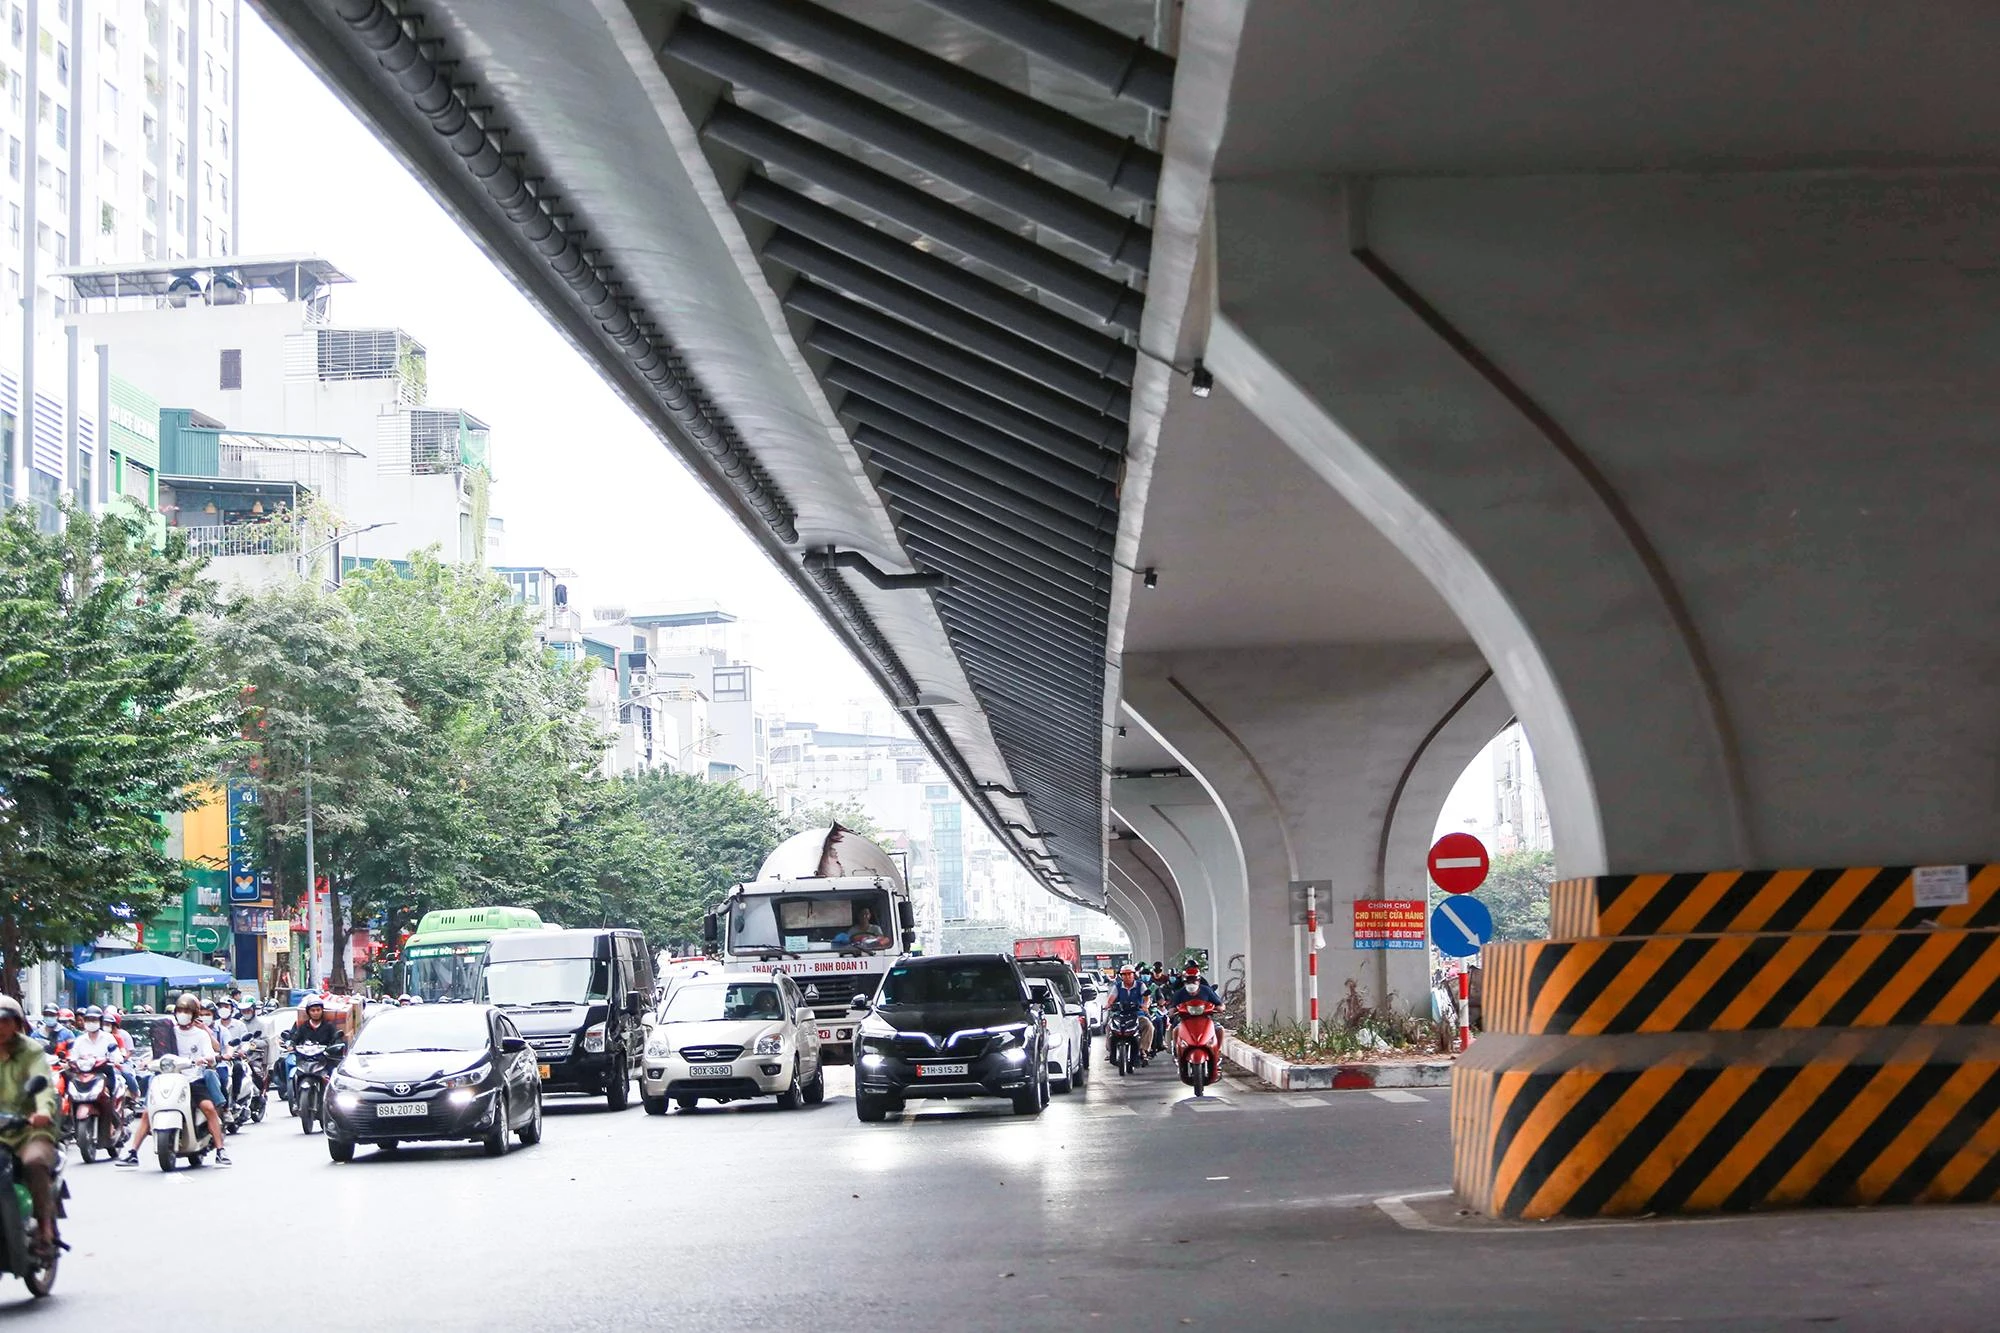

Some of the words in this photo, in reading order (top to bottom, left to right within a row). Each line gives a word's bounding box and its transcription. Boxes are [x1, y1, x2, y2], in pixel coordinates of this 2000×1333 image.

[1355, 911, 1369, 919] CHO
[793, 963, 806, 972] 171
[859, 960, 868, 970] 11
